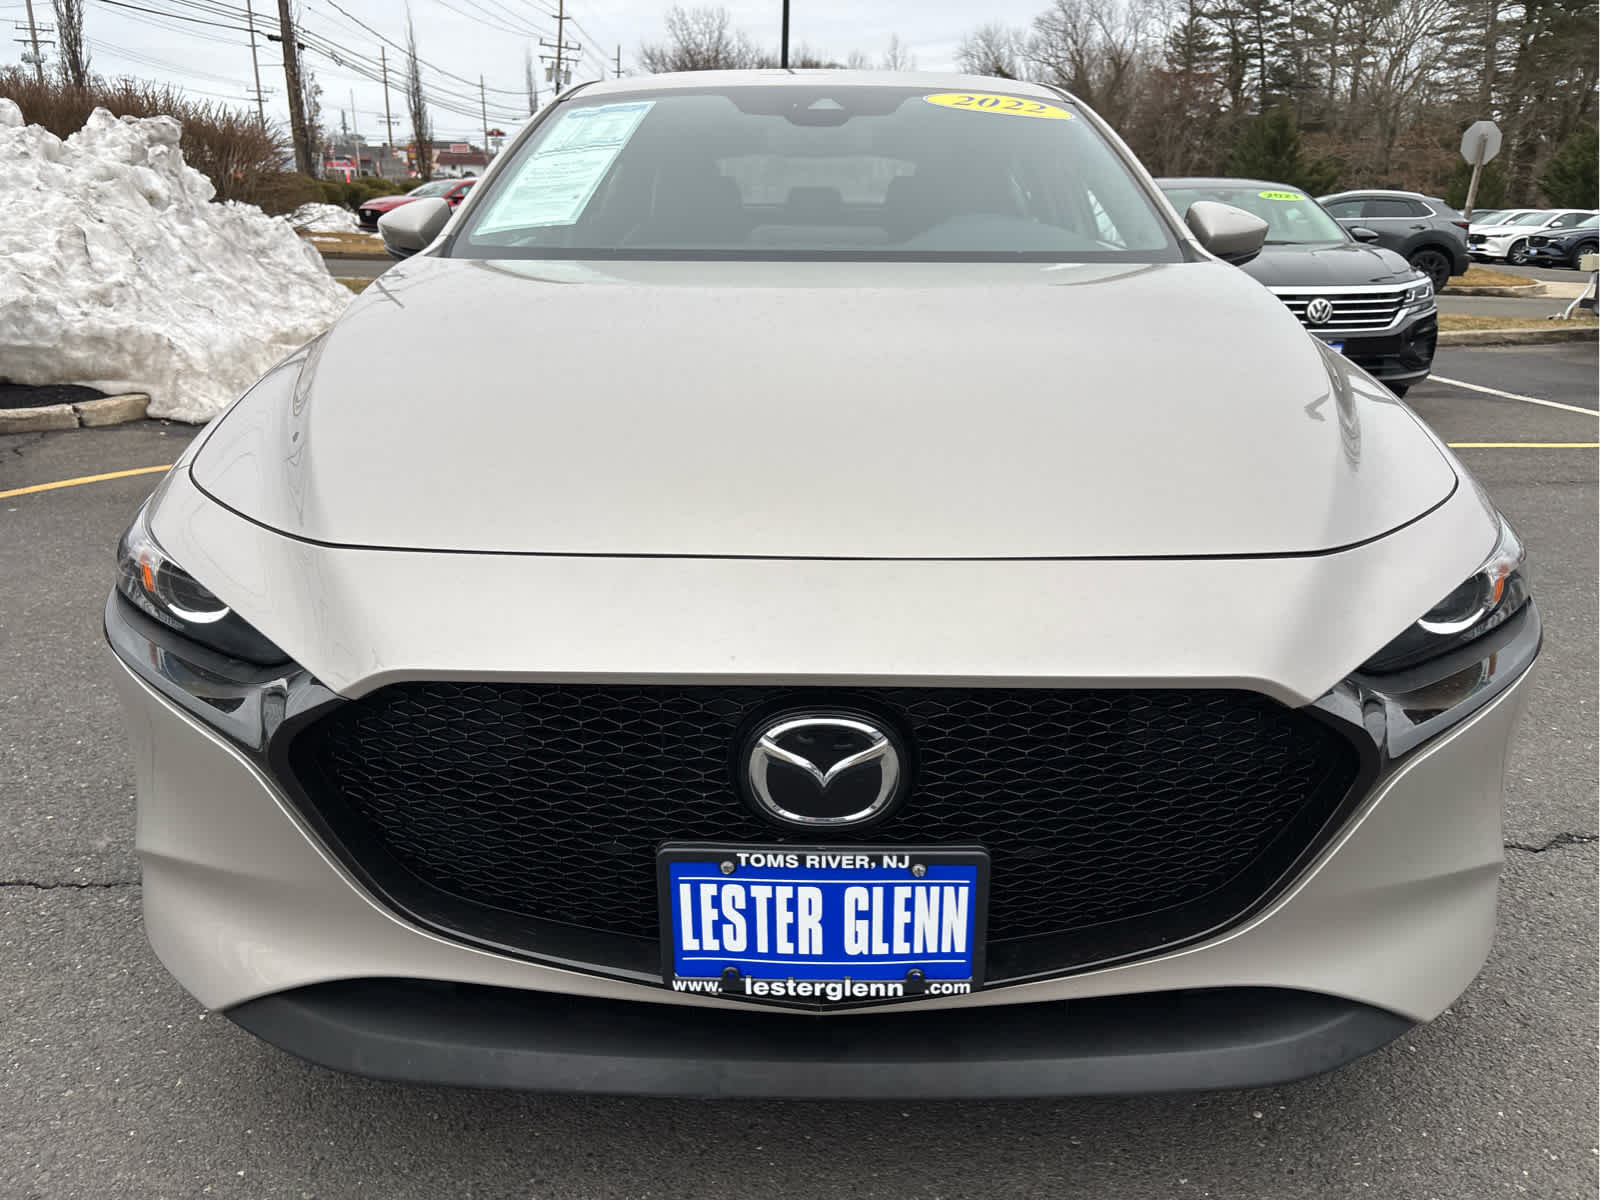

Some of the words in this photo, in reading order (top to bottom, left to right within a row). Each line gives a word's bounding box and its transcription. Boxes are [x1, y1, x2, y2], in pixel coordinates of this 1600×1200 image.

[952, 95, 1047, 113] 2022
[736, 853, 799, 868] TOMS
[806, 855, 876, 869] RIVER,
[882, 855, 910, 869] NJ
[679, 883, 823, 955] LESTER
[843, 886, 969, 955] GLENN
[672, 980, 723, 992] www.
[745, 975, 904, 1000] lesterglenn
[924, 981, 971, 995] .com
